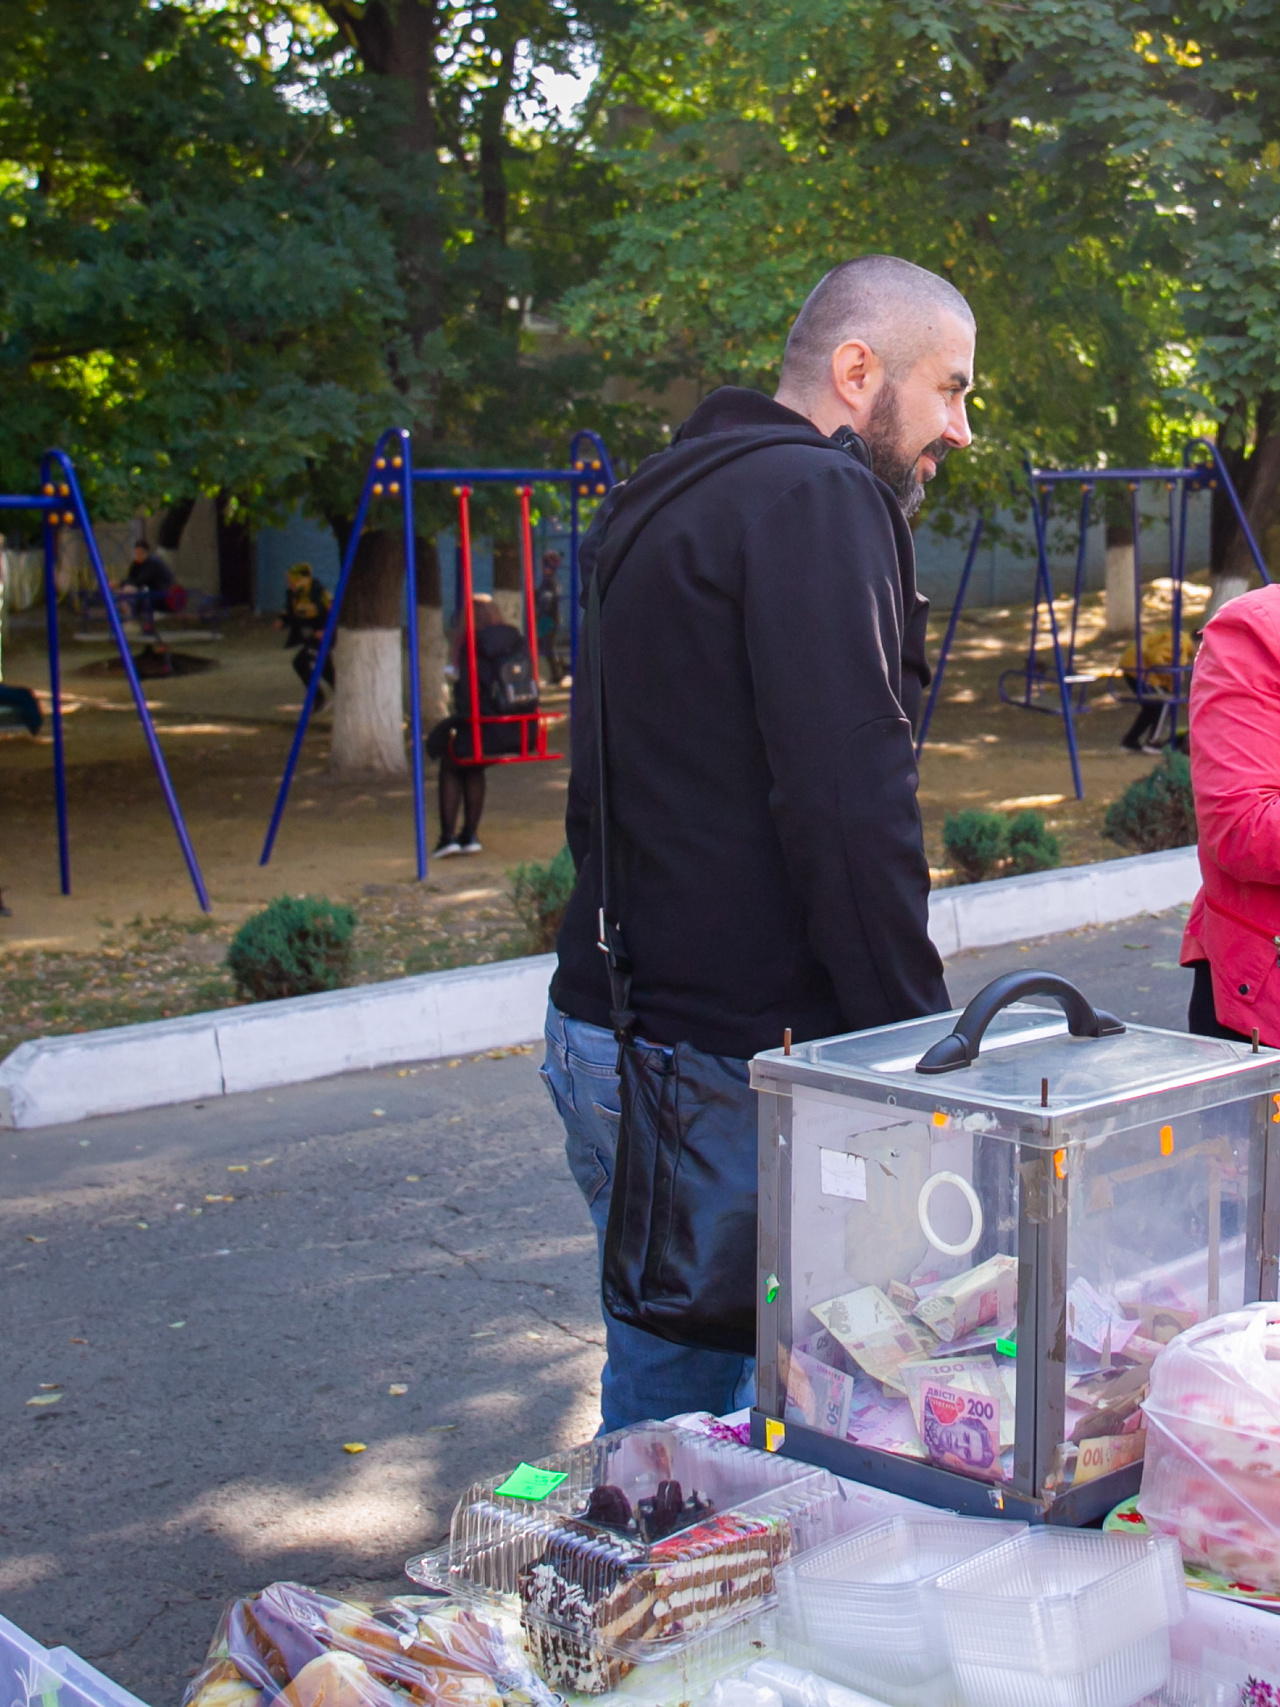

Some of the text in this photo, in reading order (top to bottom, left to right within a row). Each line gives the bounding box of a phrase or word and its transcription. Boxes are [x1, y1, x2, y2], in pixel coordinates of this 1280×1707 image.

[930, 1363, 965, 1375] 100
[926, 1387, 956, 1402] ДВІСТІ
[967, 1397, 994, 1421] 200
